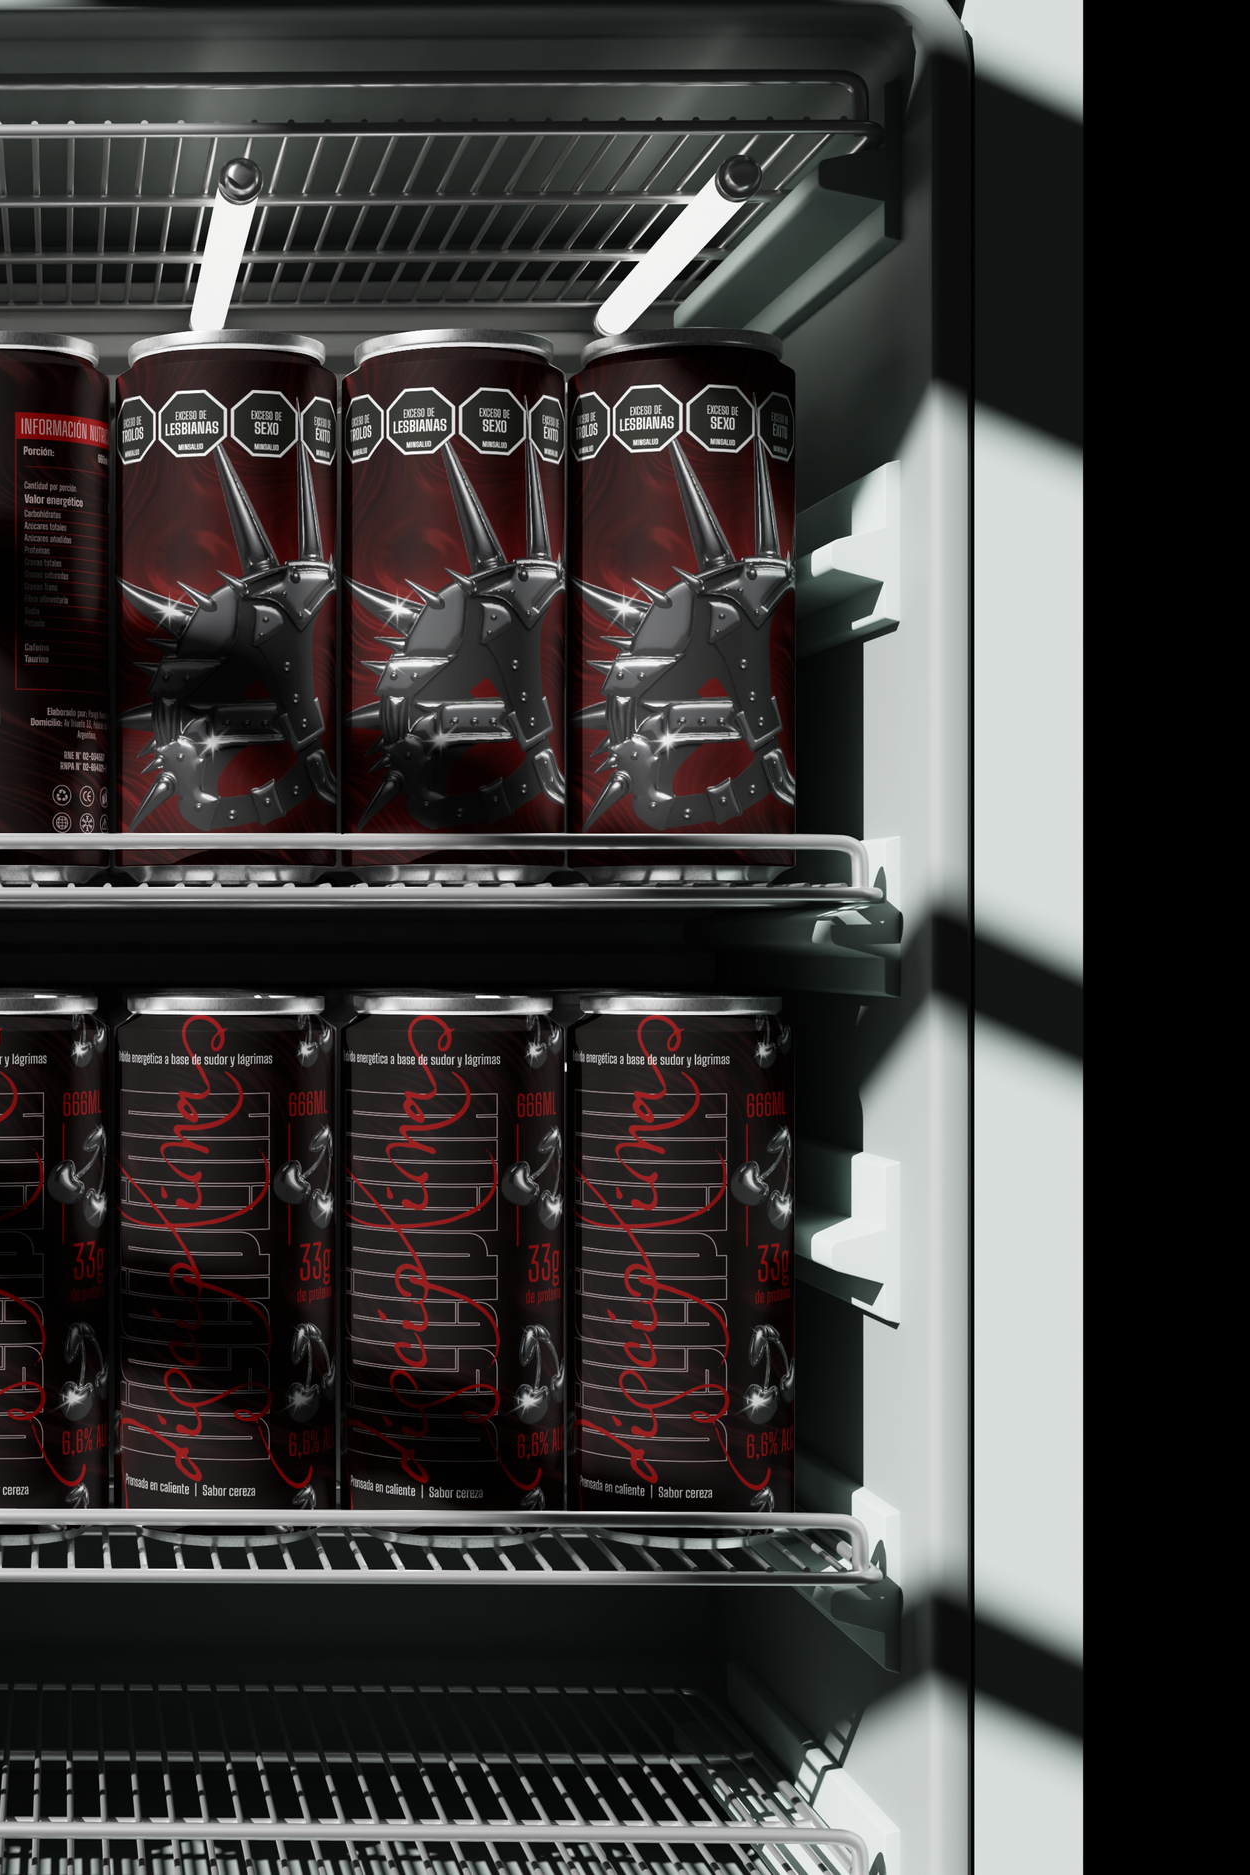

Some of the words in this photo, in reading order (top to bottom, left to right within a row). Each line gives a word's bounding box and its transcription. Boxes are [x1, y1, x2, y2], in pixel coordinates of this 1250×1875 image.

[175, 410, 198, 421] EXCESO
[199, 410, 207, 420] DE
[251, 410, 273, 421] EXCESO
[274, 411, 282, 422] DE
[403, 408, 426, 418] EXCESO
[427, 407, 435, 417] DE
[479, 408, 501, 418] EXCESO
[502, 409, 511, 419] DE
[630, 405, 653, 416] EXCESO
[653, 405, 662, 414] DE
[706, 405, 729, 416] EXCESO
[730, 406, 739, 416] DE
[20, 418, 87, 440] INFORMACIÓN
[165, 421, 219, 436] LESBIANAS
[254, 421, 279, 436] SEXO
[393, 418, 447, 434] LESBIANAS
[482, 419, 507, 433] SEXO
[575, 423, 598, 440] TROLOS
[619, 416, 675, 432] LESBIANAS
[710, 416, 736, 431] SEXO
[122, 427, 144, 444] TROLOS
[350, 424, 372, 442] TROLOS
[178, 443, 203, 451] MINSALUD
[254, 443, 279, 451] MINSALUD
[406, 440, 432, 448] MINSALUD
[482, 440, 507, 449] MINSALUD
[632, 438, 659, 446] MINSALUD
[710, 438, 736, 446] MINSALUD
[23, 445, 55, 457] Porción:
[4, 1056, 10, 1067] y
[12, 1054, 47, 1067] lágrimas
[586, 1052, 618, 1066] energética
[619, 1057, 624, 1065] a
[626, 1053, 645, 1065] base
[647, 1053, 658, 1066] de
[659, 1054, 685, 1066] sudor
[686, 1056, 692, 1068] y
[694, 1054, 730, 1067] lágrimas
[63, 1090, 102, 1117] 666ML
[288, 1091, 328, 1119] 666ML
[516, 1091, 556, 1119] 666ML
[746, 1091, 786, 1118] 666ML
[74, 1242, 105, 1285] 33g
[299, 1243, 331, 1287] 33g
[527, 1244, 560, 1288] 33g
[757, 1243, 789, 1288] 33g
[62, 1427, 92, 1457] 6,6%
[288, 1426, 320, 1460] 6,6%
[516, 1427, 549, 1461] 6,6%
[746, 1430, 778, 1461] 6,6%
[2, 1485, 29, 1496] cereza
[579, 1474, 603, 1491] Prensada
[605, 1483, 613, 1493] en
[614, 1481, 645, 1497] caliente
[658, 1486, 683, 1498] Sabor
[685, 1487, 713, 1499] cereza
